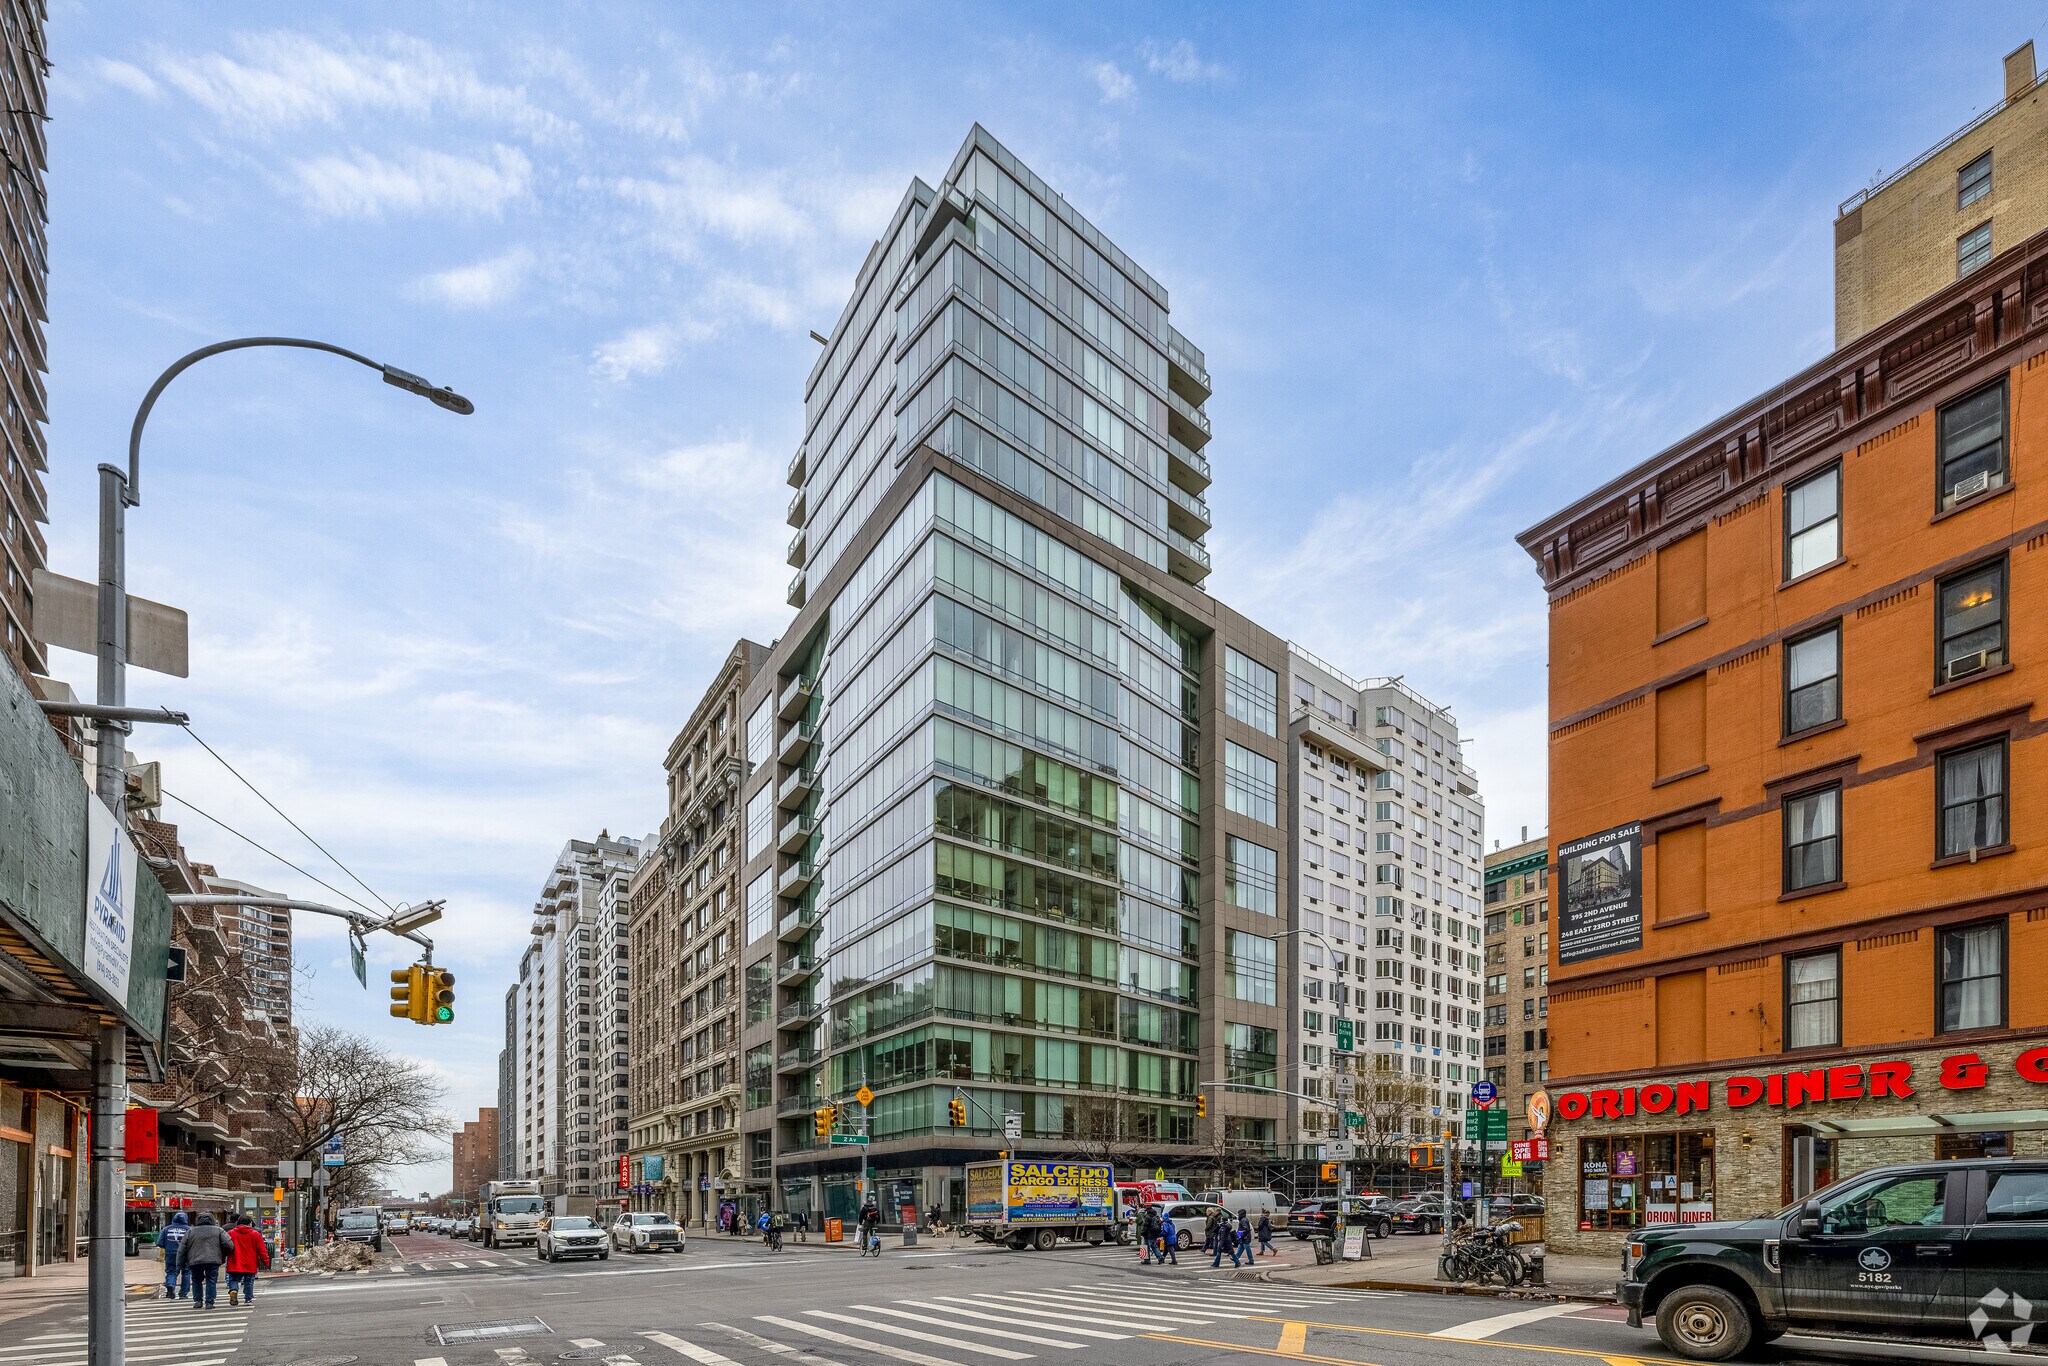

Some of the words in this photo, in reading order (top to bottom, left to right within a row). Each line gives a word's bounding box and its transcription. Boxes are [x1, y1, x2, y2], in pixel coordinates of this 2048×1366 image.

[1559, 838, 1597, 857] BUILDING
[1599, 832, 1617, 845] FOR
[1618, 825, 1640, 839] SALE
[1570, 912, 1583, 921] 395
[1584, 908, 1599, 918] 2ND
[1599, 901, 1628, 914] AVENUE
[94, 895, 126, 944] PYRAMID
[1561, 930, 1574, 939] 248
[1574, 925, 1592, 935] EAST
[1592, 921, 1611, 931] 23RD
[1611, 914, 1640, 926] STREET
[1560, 940, 1581, 948] MIXED-USE
[1581, 933, 1611, 943] DEVELOPMENT
[1610, 925, 1641, 936] OPPORTUNITY
[1338, 1028, 1352, 1036] Drive
[1557, 1081, 1709, 1120] ORION
[1726, 1060, 1915, 1109] DINER
[1939, 1052, 1988, 1089] &
[1466, 1117, 1479, 1125] BM2
[1010, 1163, 1109, 1179] SALCEDO
[1583, 1161, 1608, 1169] KONA
[1010, 1176, 1055, 1186] CARGO
[1057, 1177, 1109, 1187] EXPRESS
[1668, 1176, 1676, 1184] A
[1646, 1210, 1677, 1223] ORION
[1681, 1211, 1712, 1223] DINER
[1858, 1272, 1892, 1283] 5182
